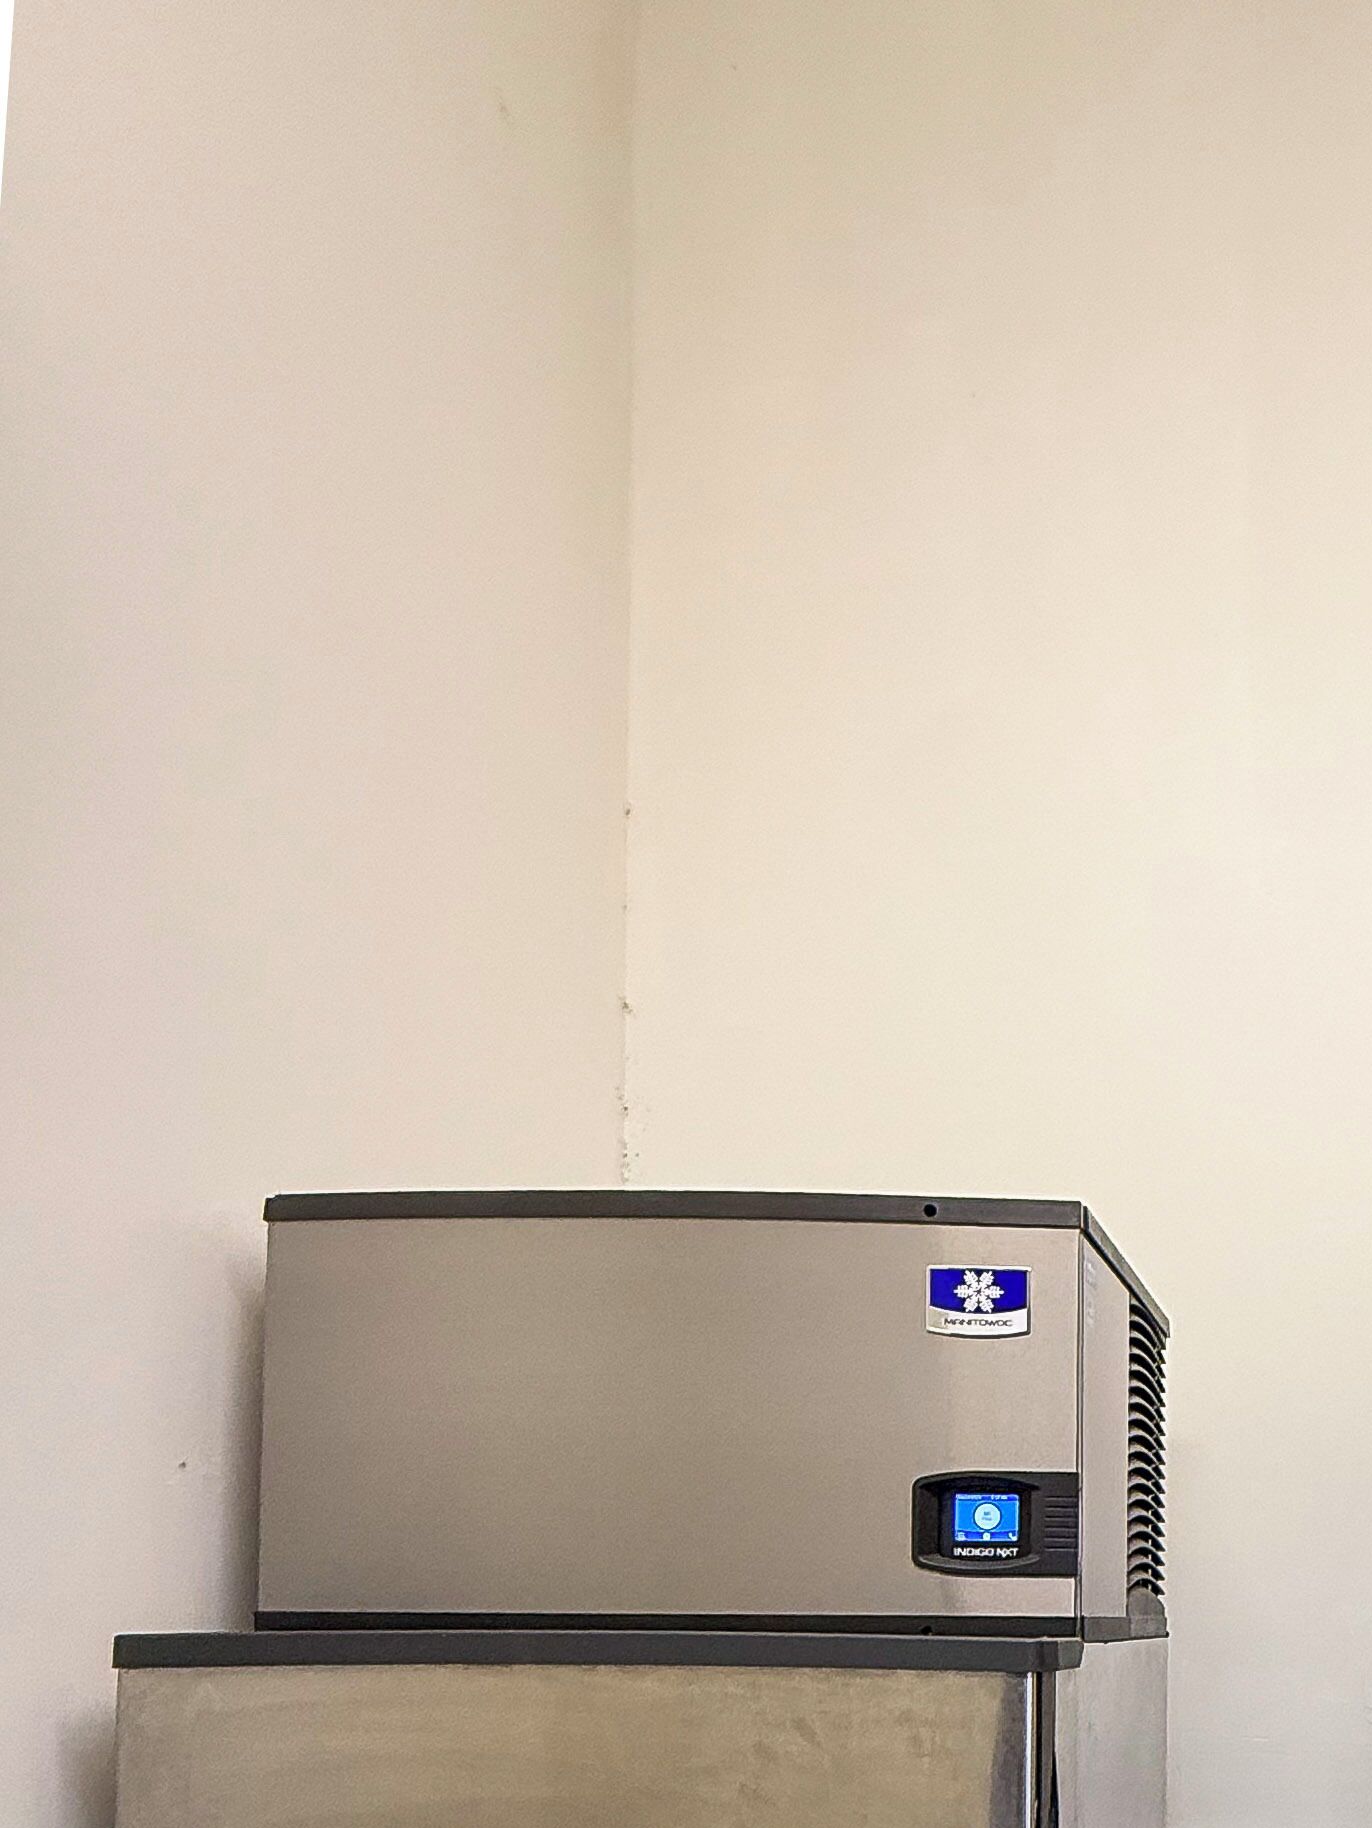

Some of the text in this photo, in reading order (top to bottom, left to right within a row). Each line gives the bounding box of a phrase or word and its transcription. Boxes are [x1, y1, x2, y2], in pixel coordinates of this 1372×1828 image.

[944, 1318, 1013, 1327] MANITOWOC
[953, 1547, 1019, 1558] INDIGO NXT
